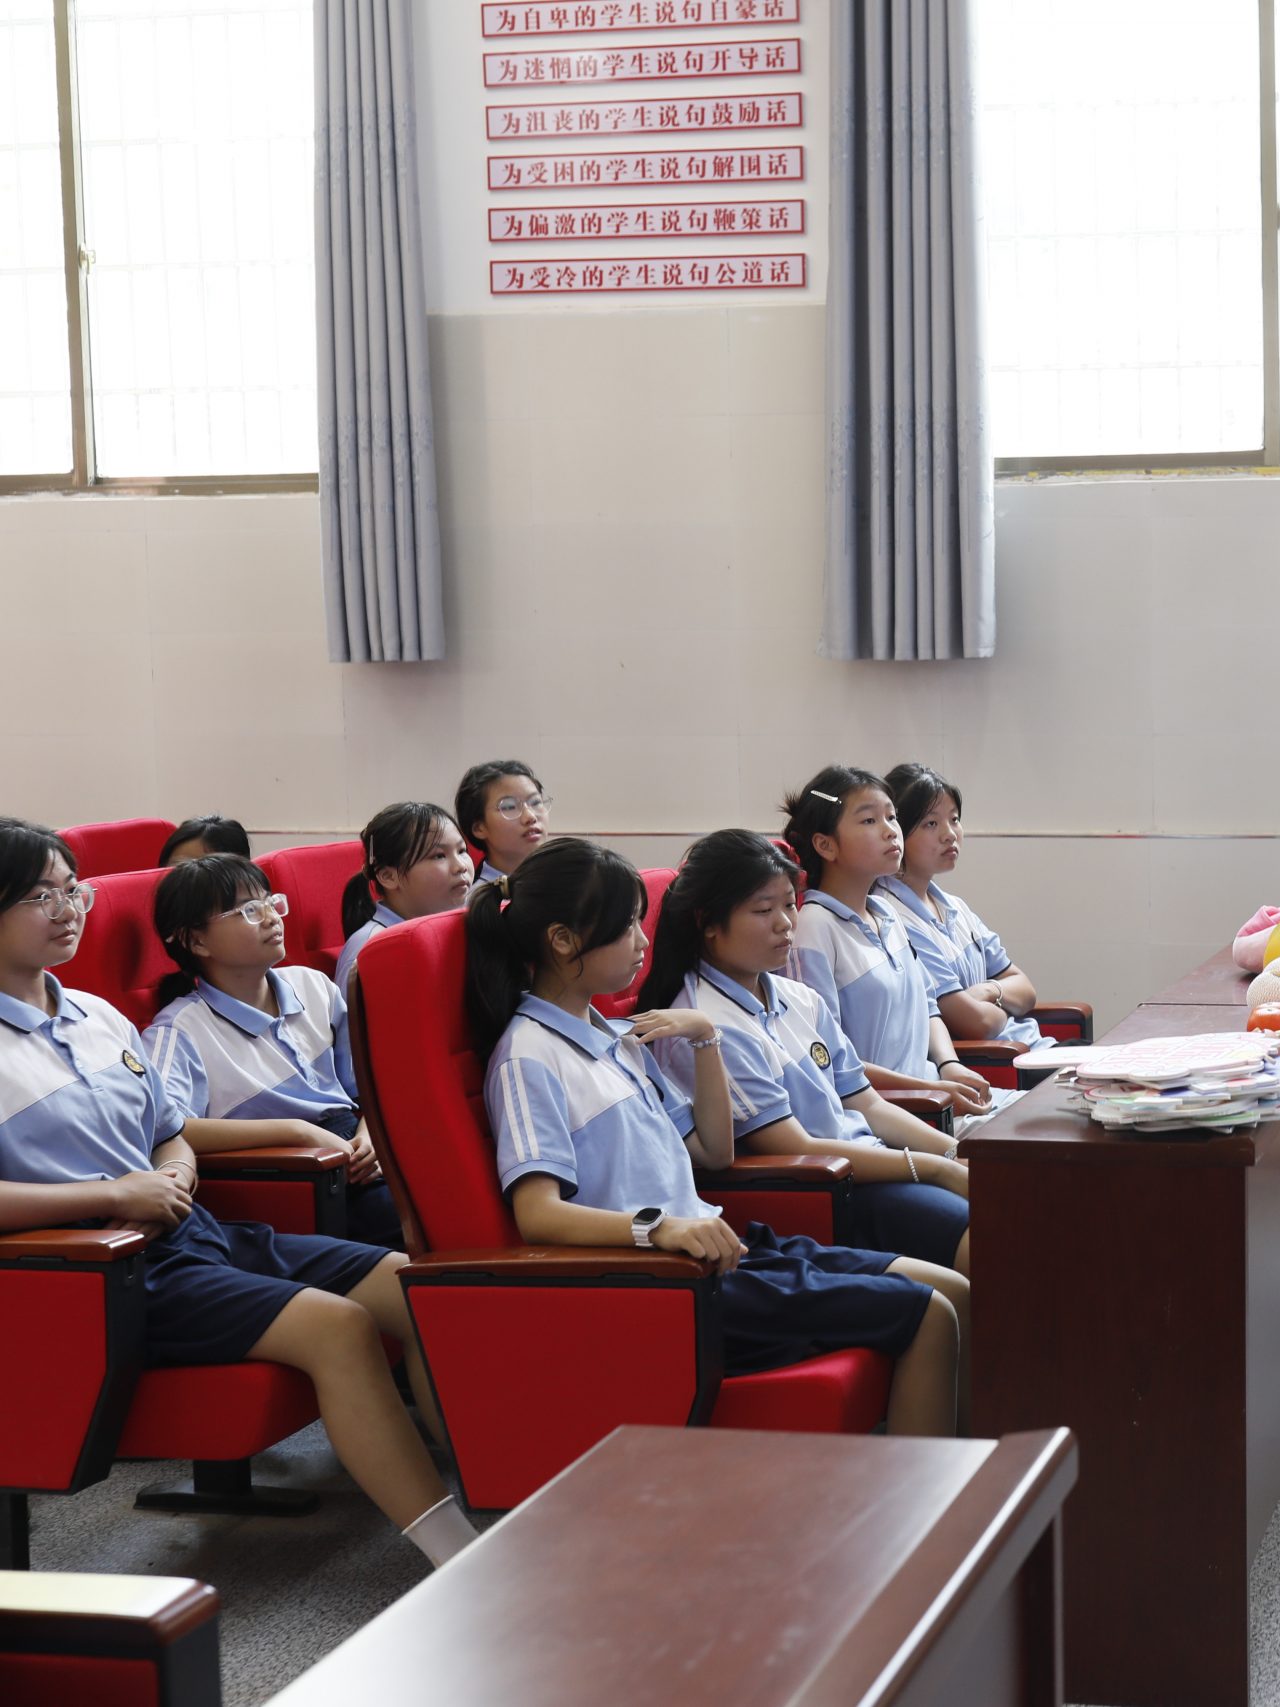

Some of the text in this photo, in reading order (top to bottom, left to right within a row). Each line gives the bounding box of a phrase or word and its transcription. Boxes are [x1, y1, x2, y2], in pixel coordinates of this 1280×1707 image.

[496, 0, 785, 32] 为自卑的学生说句自豪话
[498, 46, 786, 81] 为迷惘的学生说句开导话
[501, 100, 787, 134] 为沮丧的学生说句鼓励话
[502, 153, 788, 184] 为受困的学生说句解围话
[503, 207, 789, 237] 为偏激的学生说句鞭策话
[504, 261, 790, 289] 为受冷的学生说句公道话
